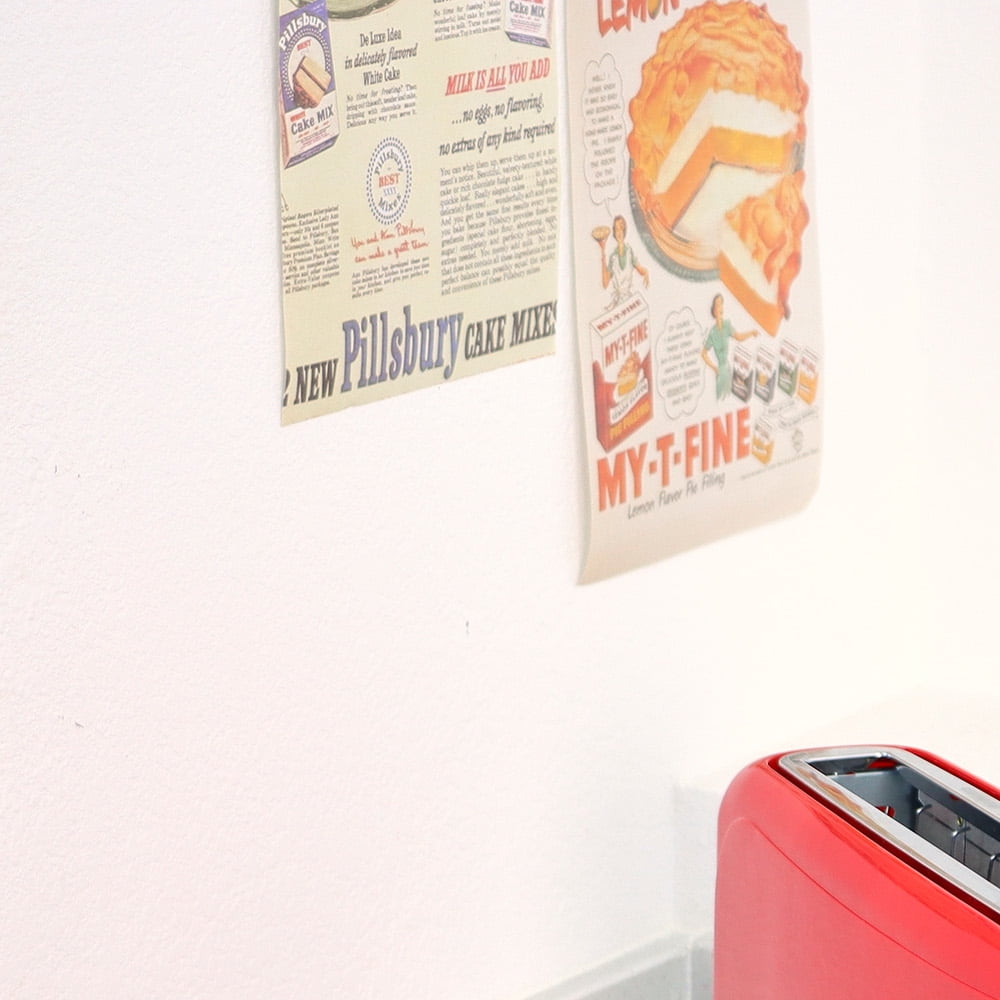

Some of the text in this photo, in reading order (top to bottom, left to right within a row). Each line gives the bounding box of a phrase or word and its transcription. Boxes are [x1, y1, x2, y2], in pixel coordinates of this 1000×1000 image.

[279, 12, 327, 50] Pillsbury
[360, 27, 402, 47] De Luxe Idea
[354, 48, 387, 68] delicately
[387, 43, 418, 65] flavored
[363, 66, 400, 86] White Cake
[445, 57, 550, 96] MILK IS ALL YOU ADD
[291, 117, 315, 135] Cake
[317, 104, 334, 123] MIX
[495, 105, 505, 117] no
[439, 117, 556, 156] no extras of any kind required
[378, 172, 400, 188] BEST
[293, 358, 339, 405] NEW
[341, 304, 464, 393] Pillsbury
[465, 315, 507, 360] CAKE
[627, 472, 726, 520] Lemon Flavor Pie Filling
